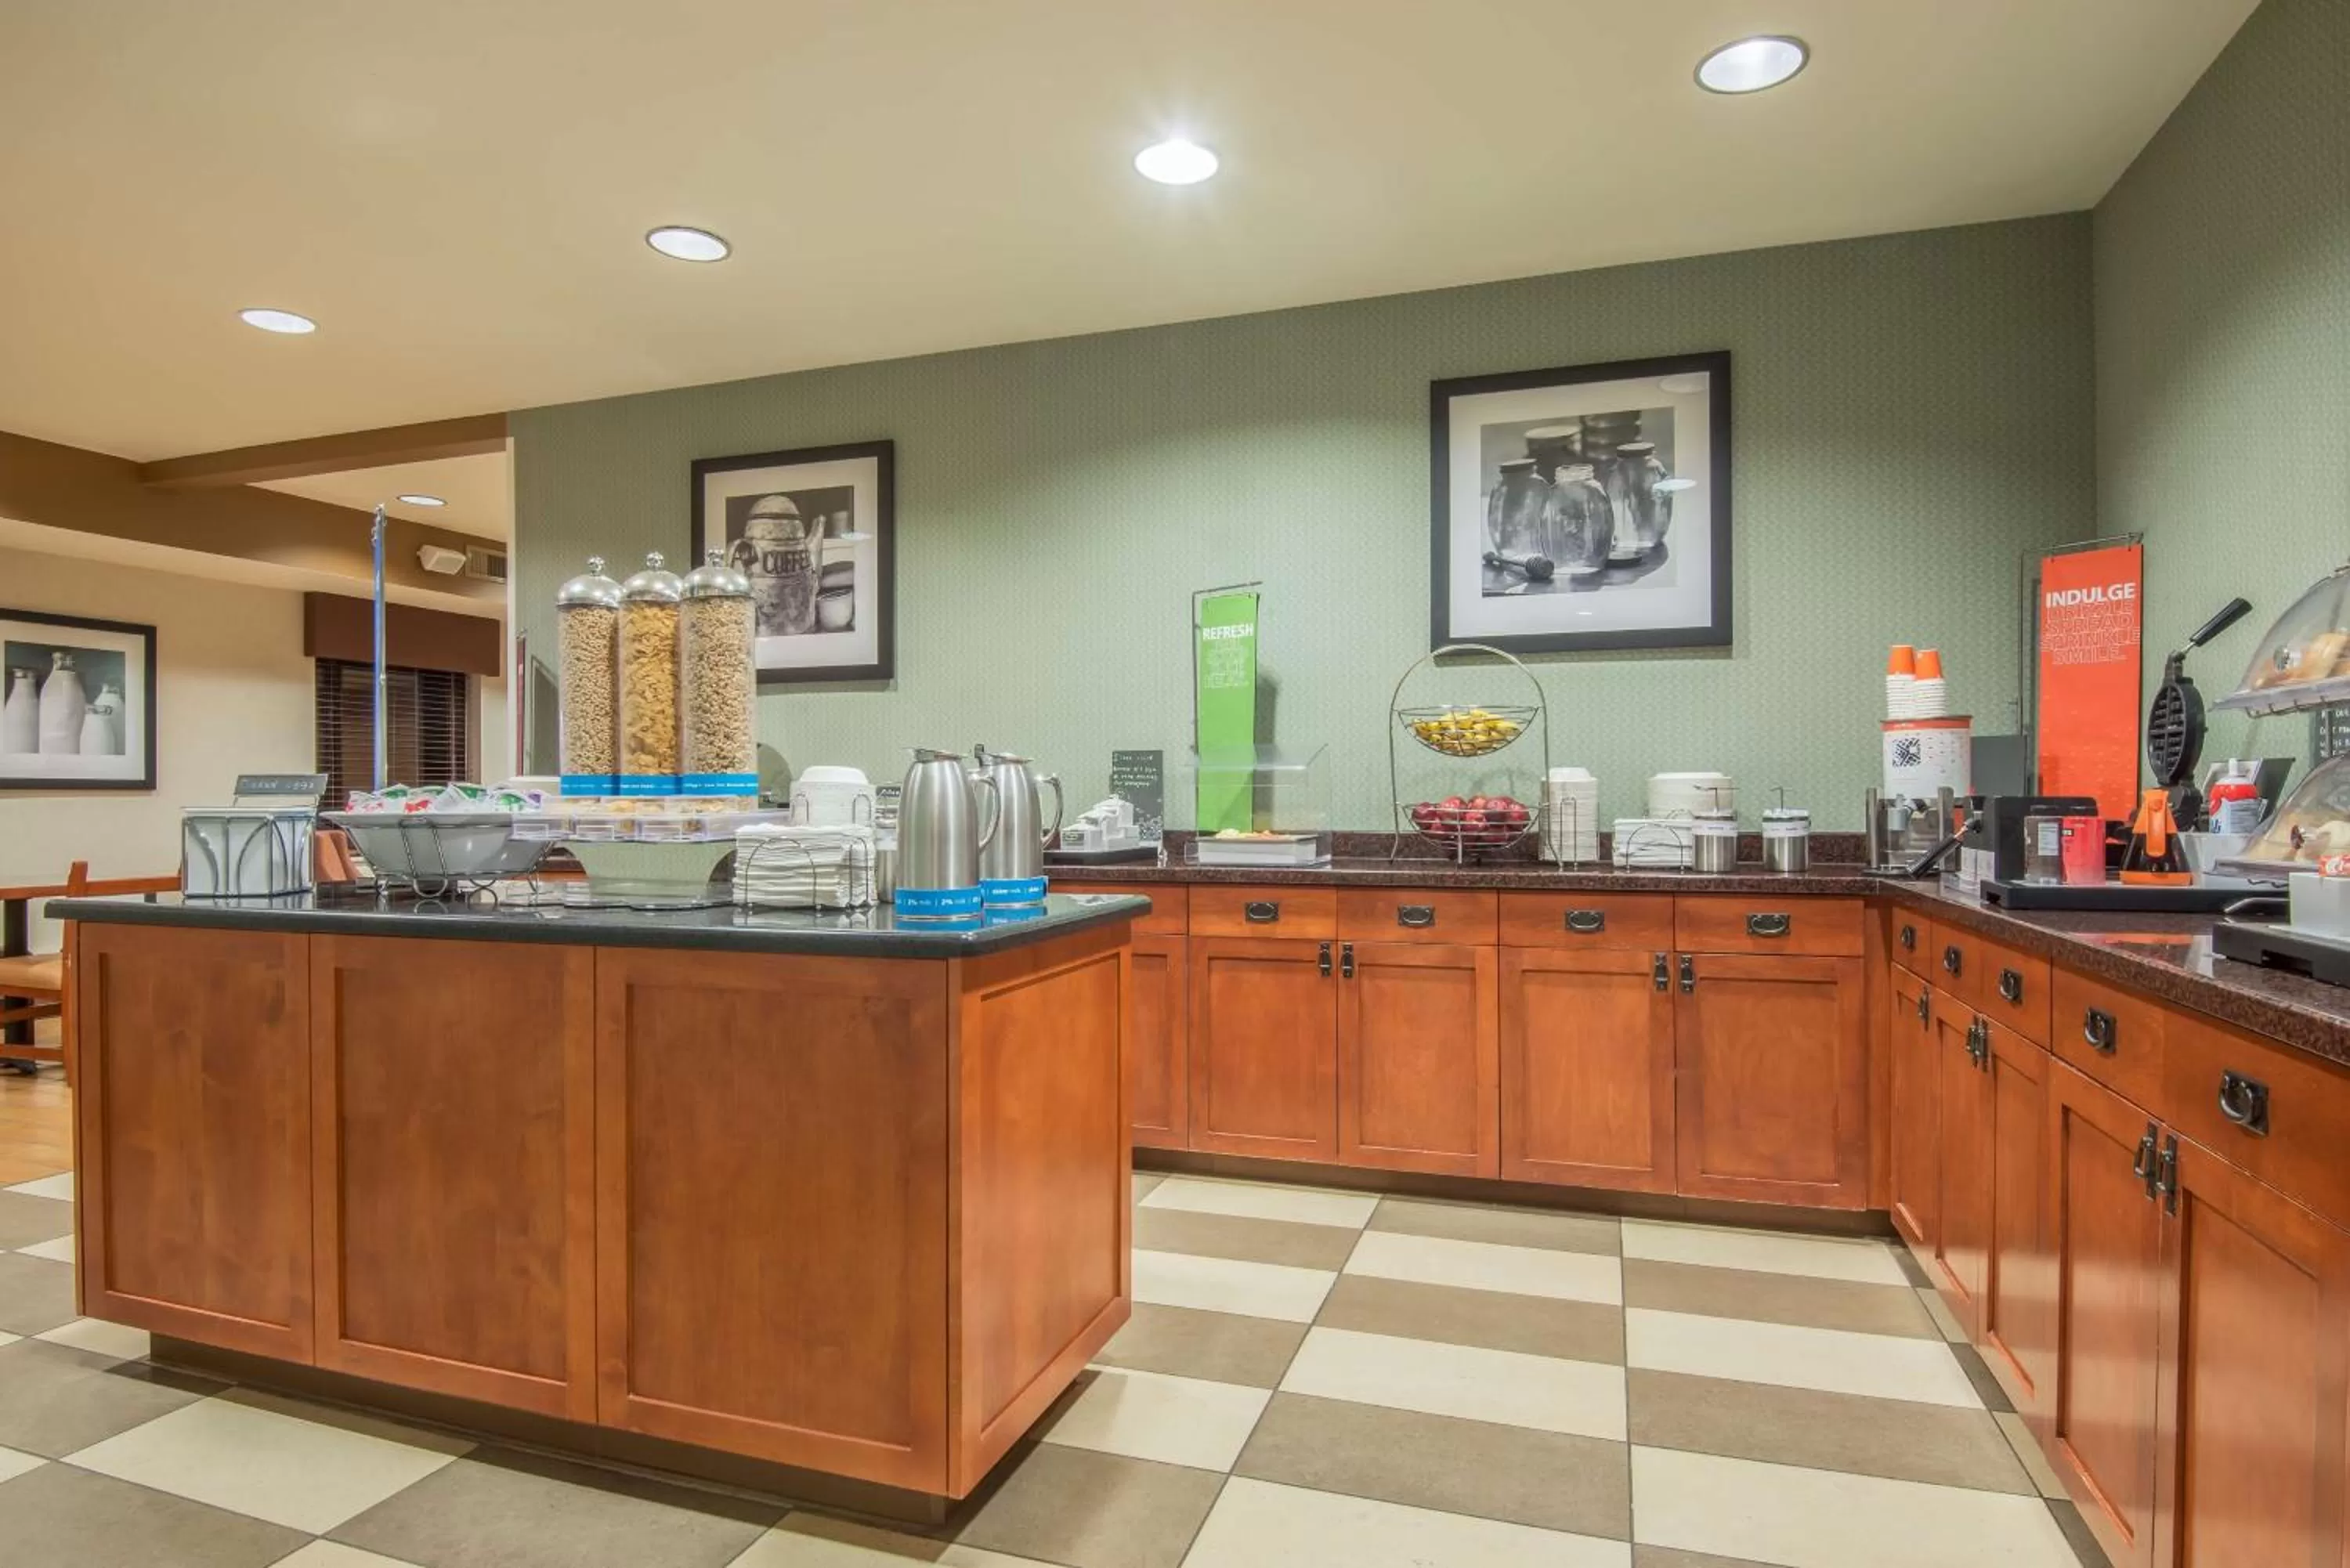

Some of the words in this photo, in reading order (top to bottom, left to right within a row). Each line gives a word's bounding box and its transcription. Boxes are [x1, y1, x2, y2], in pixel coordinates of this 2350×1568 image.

[2045, 583, 2136, 608] INDULGE
[1202, 623, 1254, 640] REFRESH
[2045, 613, 2135, 635] SPREAD
[2041, 627, 2140, 652] SPRINKLE
